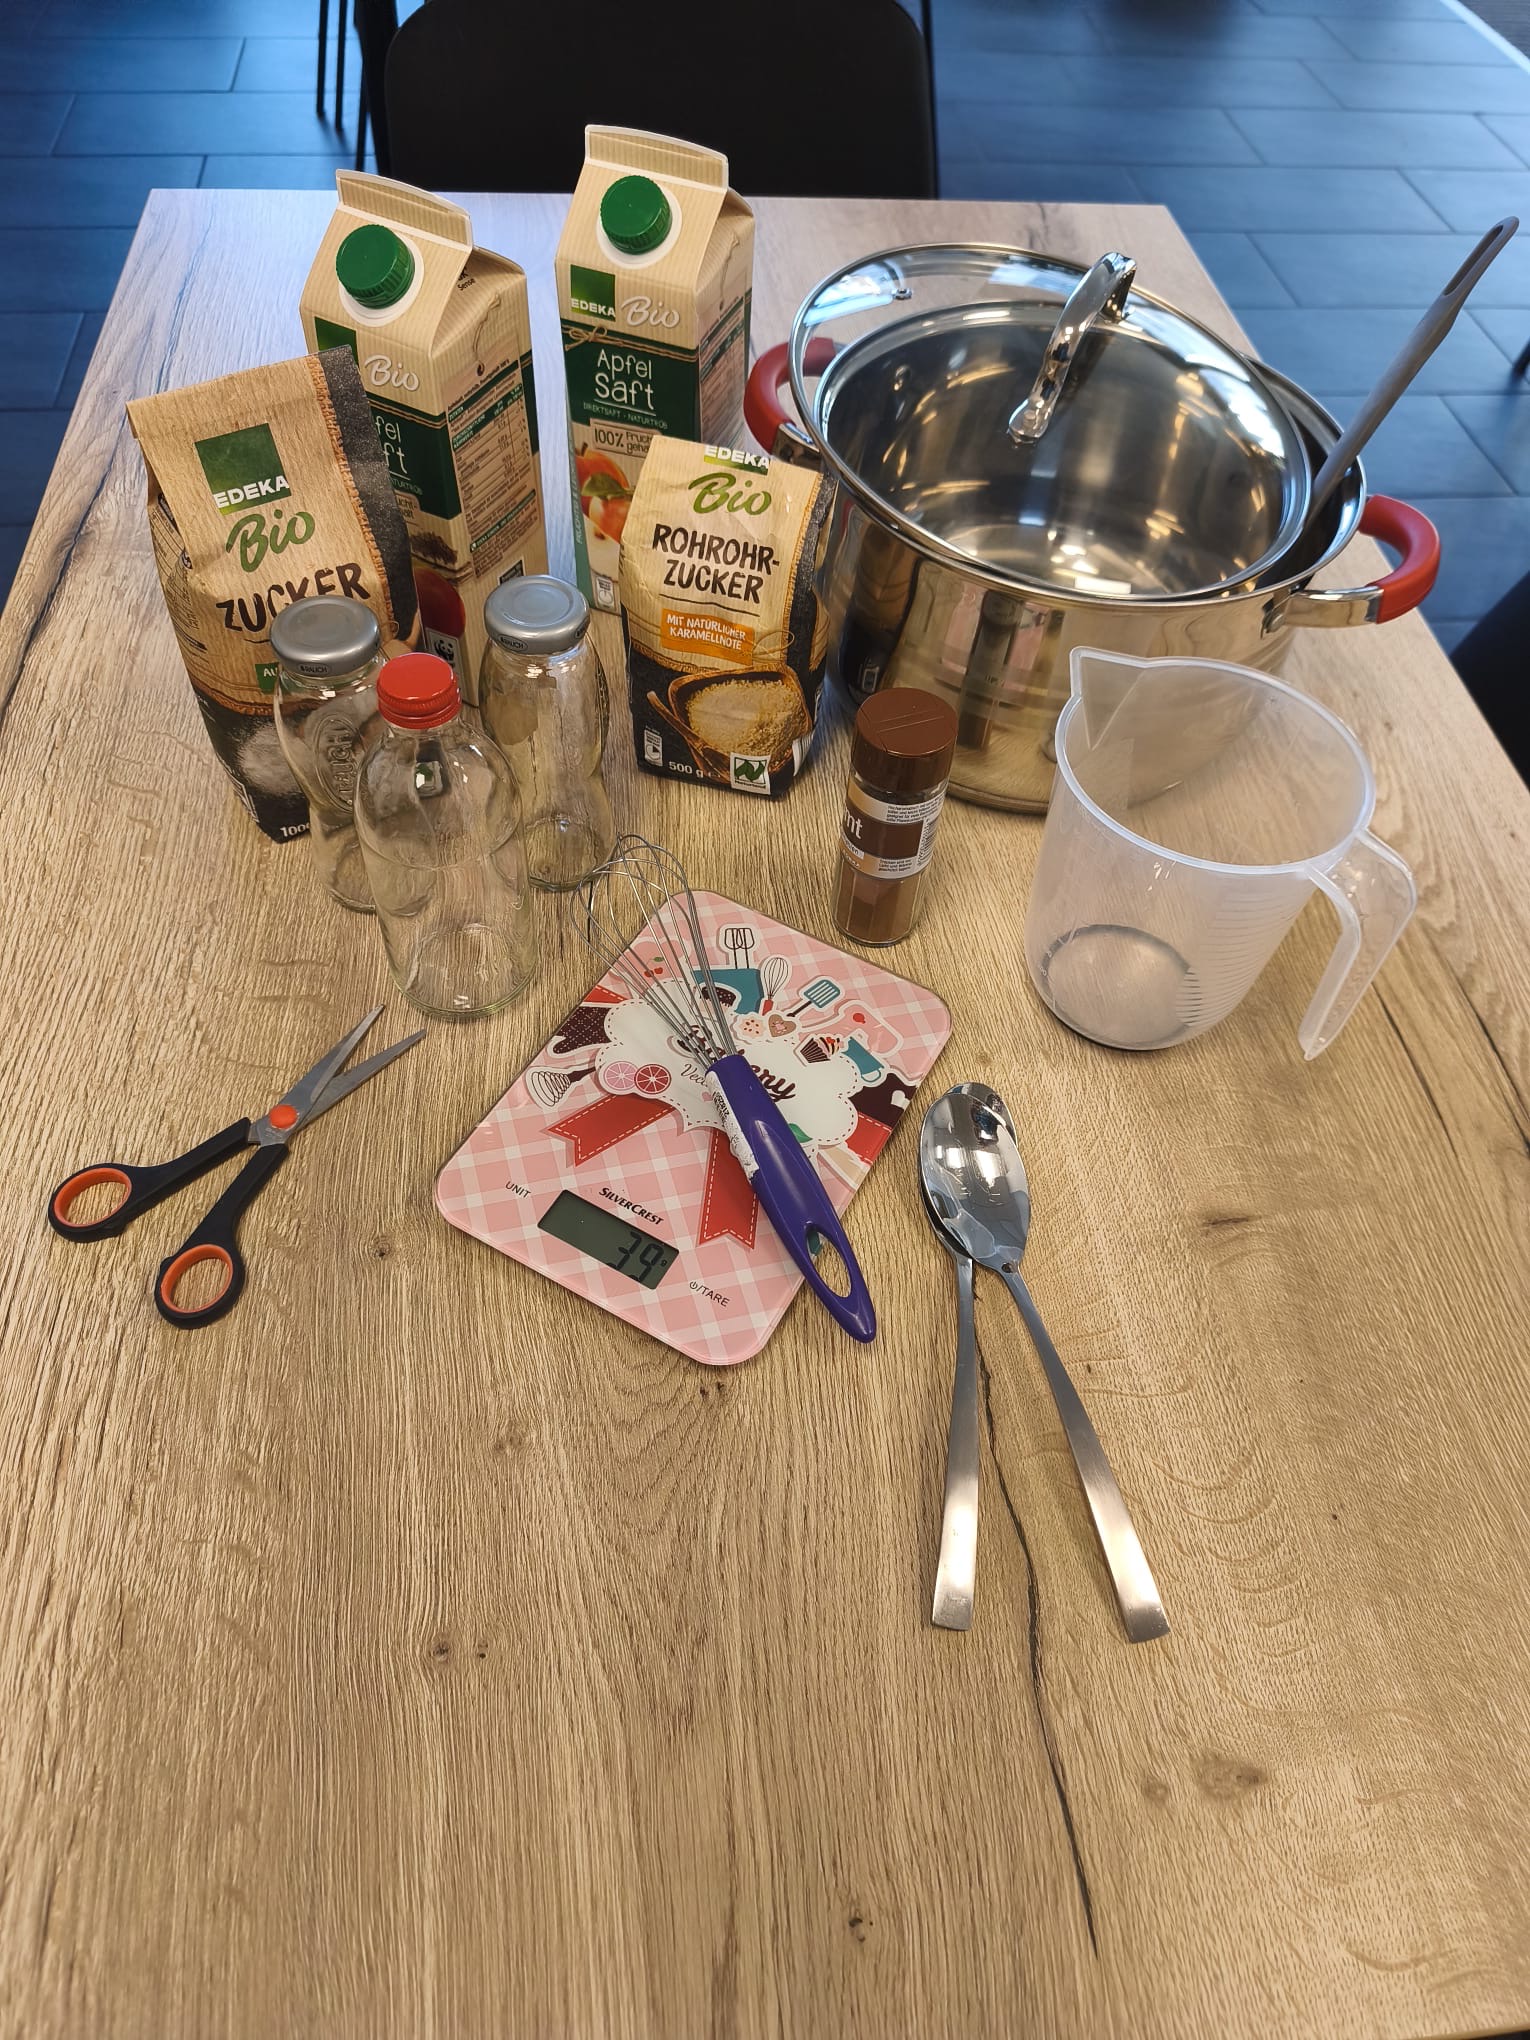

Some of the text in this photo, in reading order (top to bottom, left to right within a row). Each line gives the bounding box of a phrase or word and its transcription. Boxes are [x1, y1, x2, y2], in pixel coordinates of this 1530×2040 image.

[570, 299, 616, 318] EDEKA
[621, 296, 680, 328] Bio
[364, 354, 419, 391] Bio
[597, 348, 652, 380] Apfel
[594, 372, 655, 410] Saft
[374, 415, 402, 443] fel
[594, 427, 624, 448] 100%
[382, 442, 408, 474] ft
[626, 442, 650, 455] geha
[704, 445, 772, 470] EDEKA
[213, 475, 290, 509] EDEKA
[688, 472, 772, 515] Bio
[226, 509, 316, 573] Bio
[652, 523, 780, 576] ROHROHR-
[663, 559, 764, 604] ZUCKER
[666, 613, 685, 628] MIT
[669, 626, 743, 650] KARAMELLNOTE
[263, 666, 279, 677] AU
[668, 761, 693, 775] 500
[843, 803, 863, 840] mt
[505, 1180, 532, 1200] UNIT
[598, 1186, 665, 1226] SILVERCREST
[606, 1230, 665, 1284] 39
